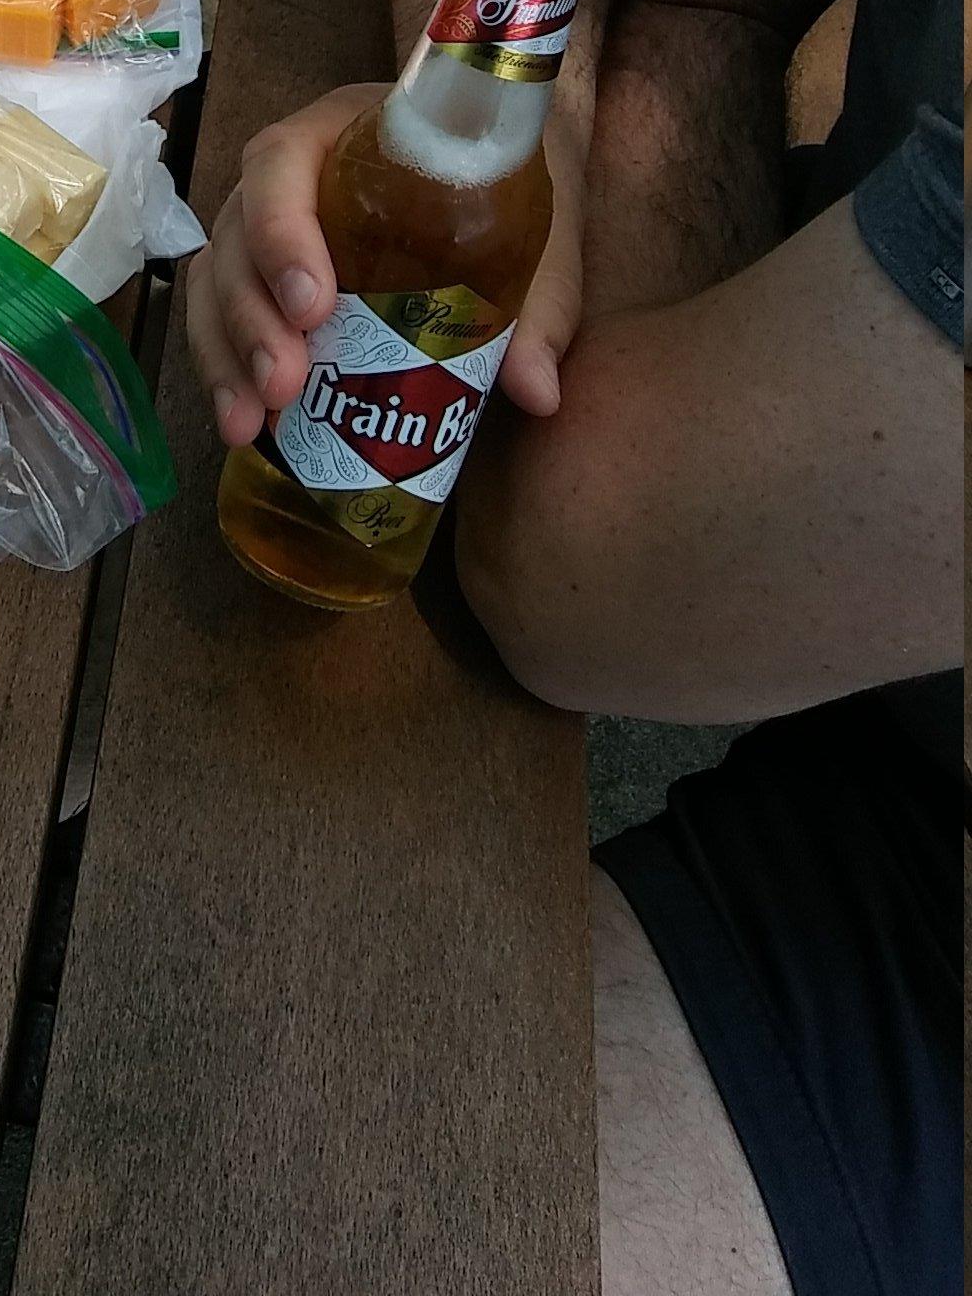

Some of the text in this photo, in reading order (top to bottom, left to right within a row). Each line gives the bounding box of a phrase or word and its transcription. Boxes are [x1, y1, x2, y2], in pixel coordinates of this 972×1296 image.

[401, 298, 493, 340] Premium
[300, 361, 488, 456] Grain Bel
[347, 492, 407, 529] Beer
